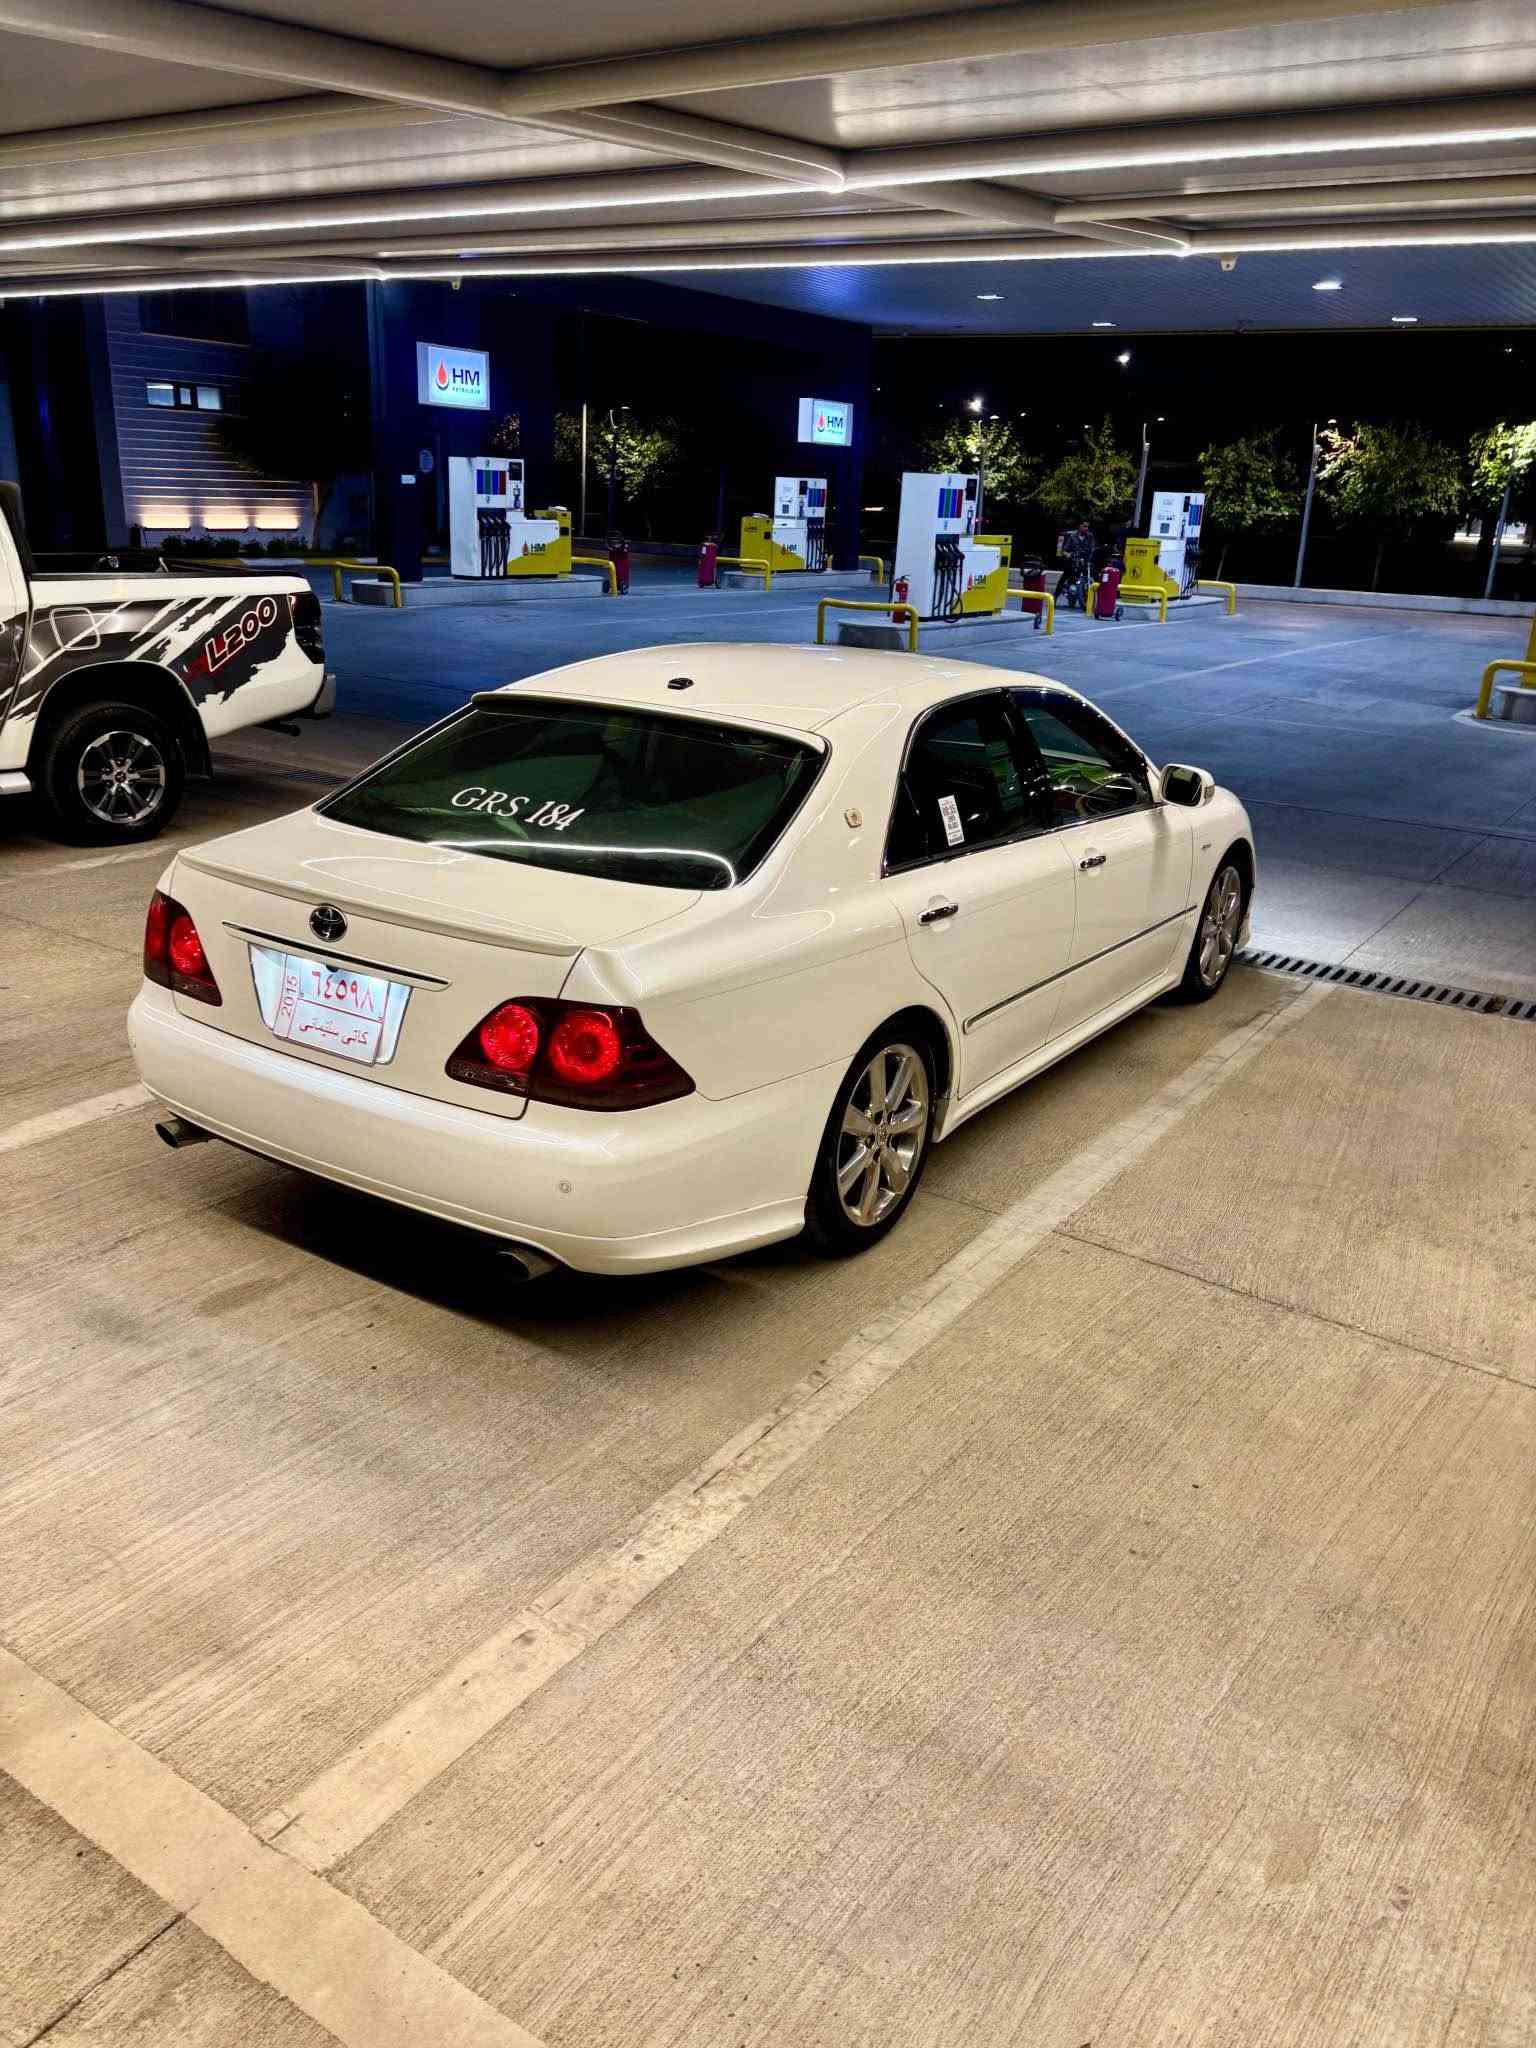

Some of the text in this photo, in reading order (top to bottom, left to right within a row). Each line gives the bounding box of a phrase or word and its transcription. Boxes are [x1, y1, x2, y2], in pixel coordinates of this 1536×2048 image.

[452, 368, 480, 386] HM
[827, 415, 844, 429] HM
[531, 543, 546, 553] HM
[205, 597, 277, 672] L200
[452, 787, 585, 831] GRS 184
